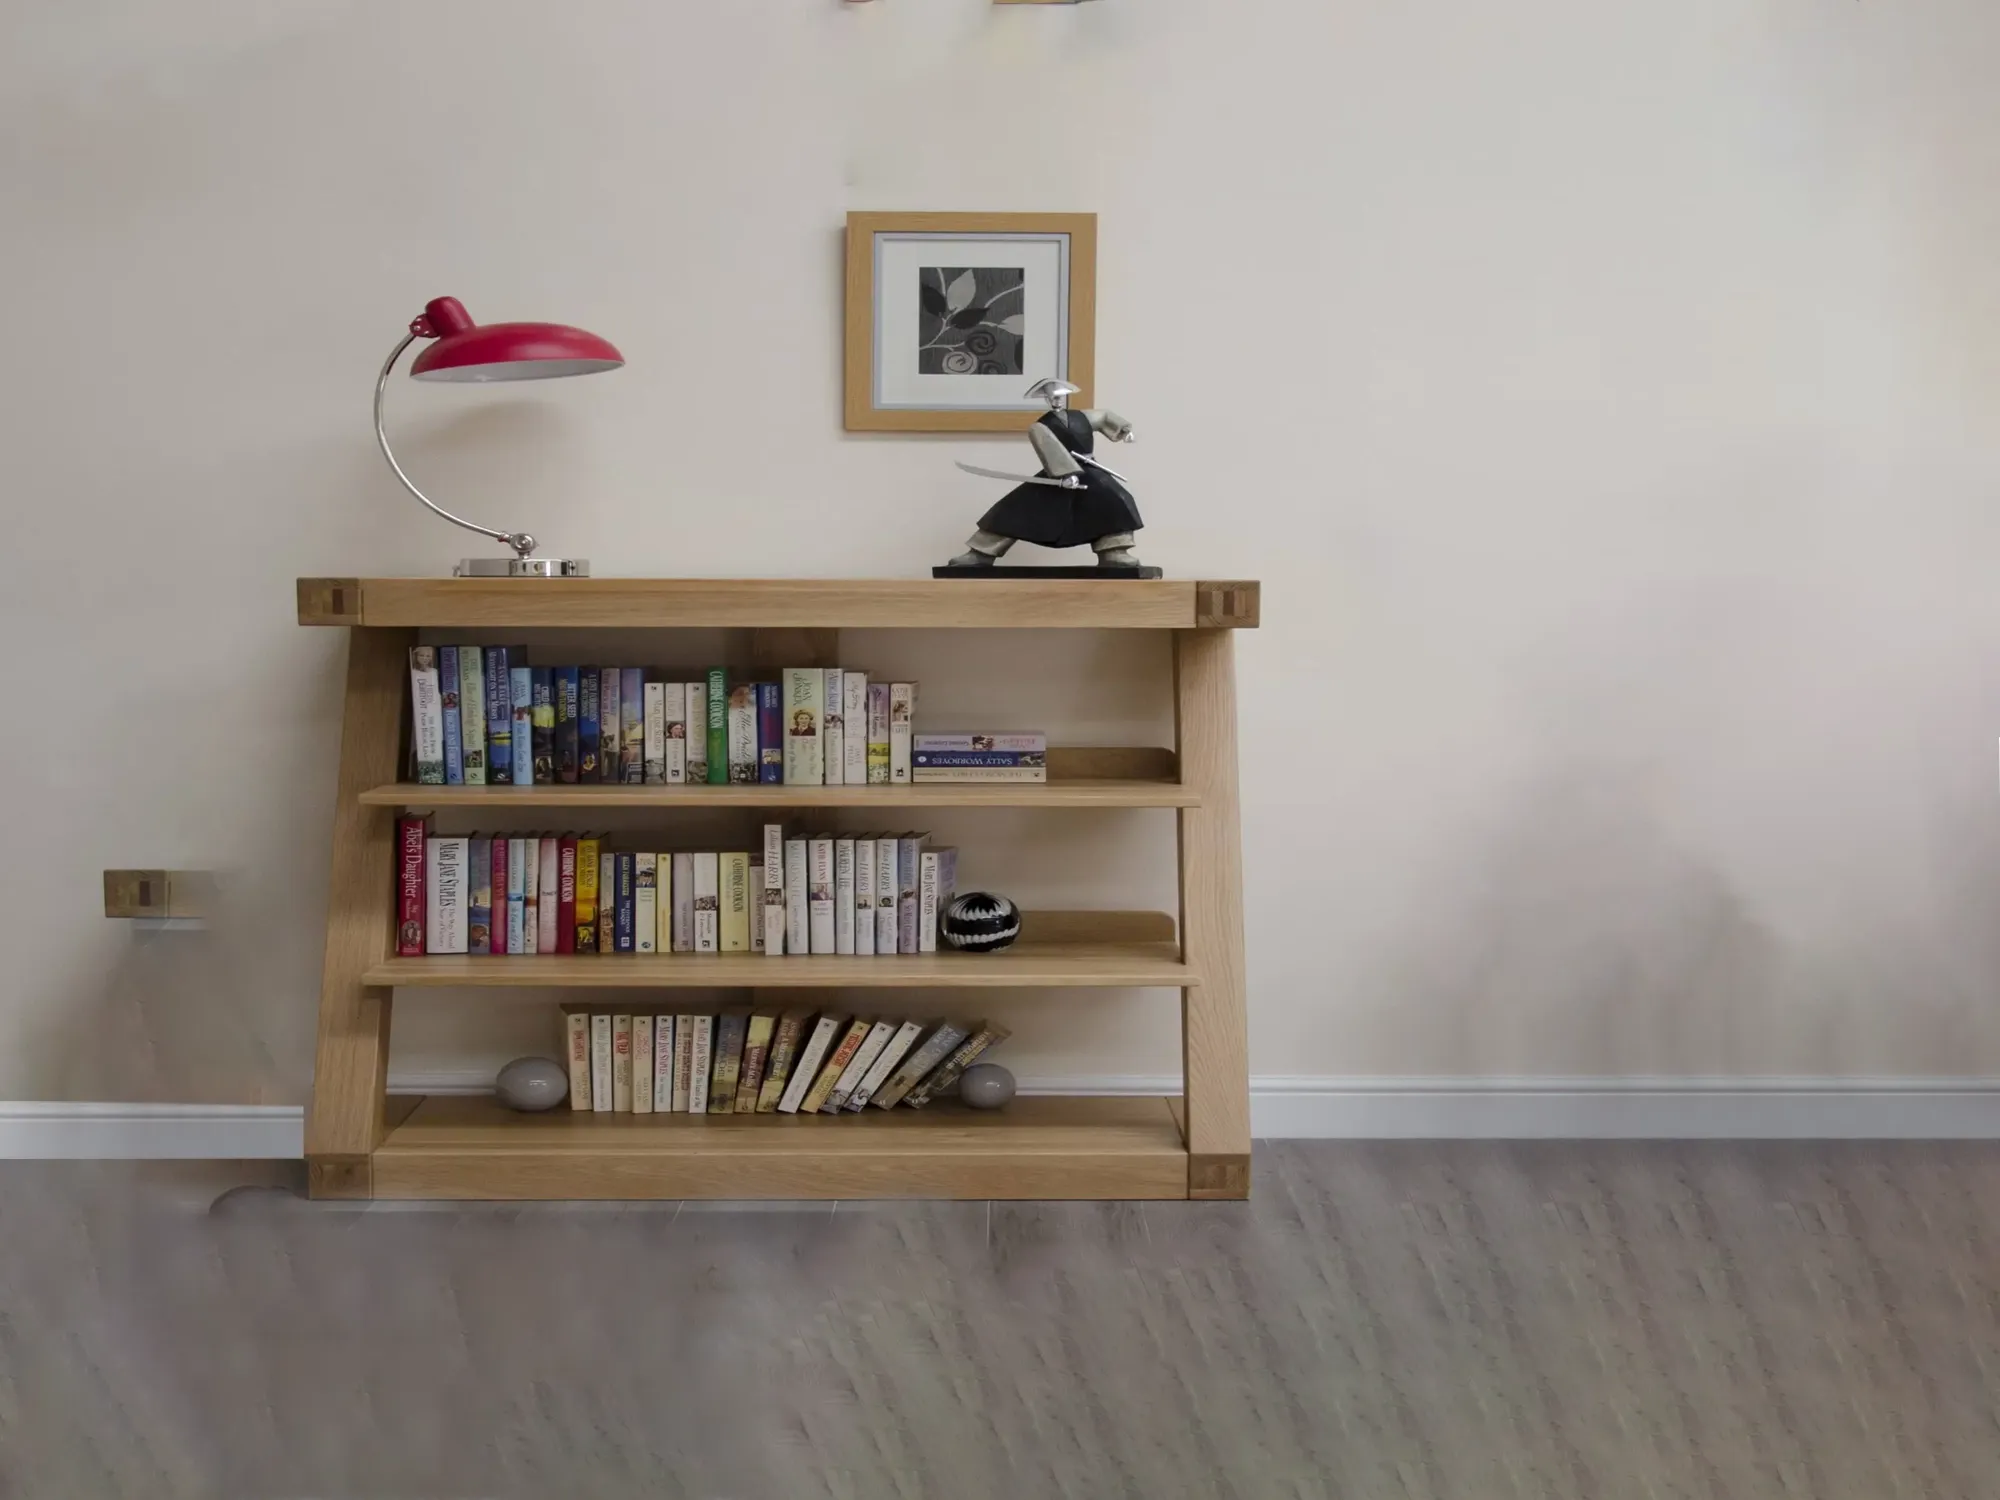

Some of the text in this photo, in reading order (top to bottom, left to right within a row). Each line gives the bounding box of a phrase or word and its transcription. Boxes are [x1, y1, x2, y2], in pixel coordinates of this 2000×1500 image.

[567, 683, 577, 718] BITTER SEED
[709, 671, 724, 701] CATHERINE
[792, 672, 803, 707] JONKER
[802, 679, 814, 701] JOAN
[709, 702, 725, 729] COOKSON
[986, 757, 1014, 766] SALLY
[402, 827, 422, 898] Abel's Daughter
[767, 829, 780, 889] Lilian HARRY
[924, 865, 936, 880] MARY
[437, 842, 461, 907] MARY JANE STAPLES
[562, 848, 575, 903] CATHERINE COOKSON
[731, 858, 745, 912] CATHERINE COOKSON
[859, 862, 870, 892] HARRY
[880, 862, 891, 892] HARRY
[922, 880, 936, 894] JANE
[923, 894, 936, 916] STAPLES
[657, 1026, 671, 1075] MARY JANE STAPLES
